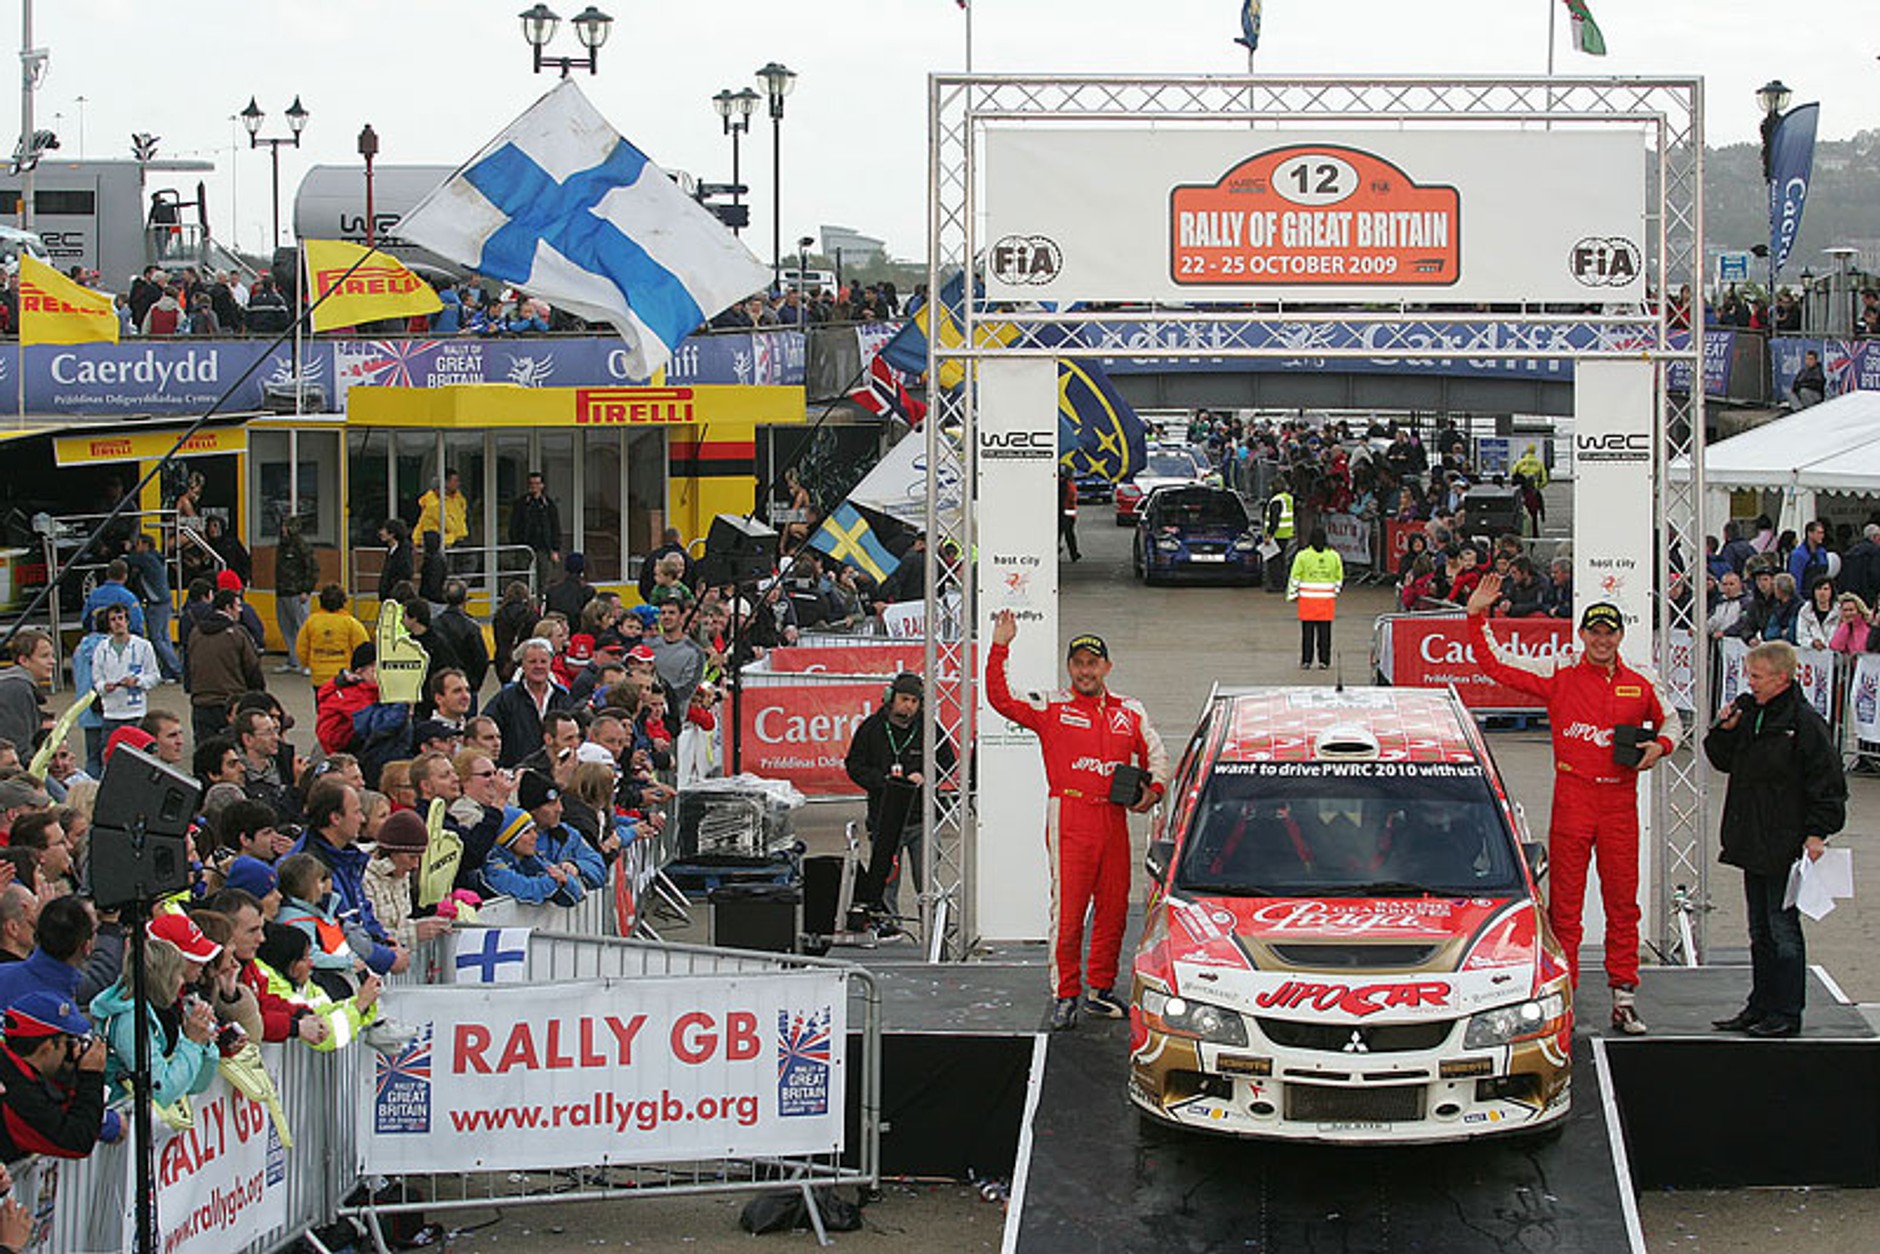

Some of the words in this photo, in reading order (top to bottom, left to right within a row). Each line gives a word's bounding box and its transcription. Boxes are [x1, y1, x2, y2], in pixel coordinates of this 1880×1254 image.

[1290, 164, 1339, 194] 12
[341, 213, 402, 232] WR
[1180, 211, 1243, 247] RALLY
[1250, 211, 1278, 247] OF
[1283, 211, 1352, 247] GREAT
[1357, 211, 1448, 247] BRITAIN
[1181, 256, 1205, 274] 22
[1221, 256, 1245, 274] 25
[1250, 256, 1345, 274] OCTOBER
[1348, 256, 1398, 274] 2009
[51, 350, 218, 392] Caerdydd
[435, 356, 483, 372] GREAT
[576, 388, 694, 424] PIRELLI
[980, 432, 1054, 447] WRC
[1577, 434, 1650, 449] WRC
[1020, 555, 1040, 567] city
[754, 701, 871, 744] Caerd
[1563, 721, 1616, 747] JIPOC
[1215, 763, 1257, 774] want
[1260, 763, 1277, 775] to
[1279, 763, 1321, 776] drive
[1322, 763, 1371, 776] PWRC
[1375, 763, 1417, 776] 2010
[1419, 763, 1456, 776] with
[1256, 981, 1451, 1017] JIPOCAR
[453, 1015, 648, 1075] RALLY
[670, 1011, 761, 1065] GB
[378, 1104, 427, 1117] BRITAIN
[450, 1090, 758, 1133] www.rallygb.org
